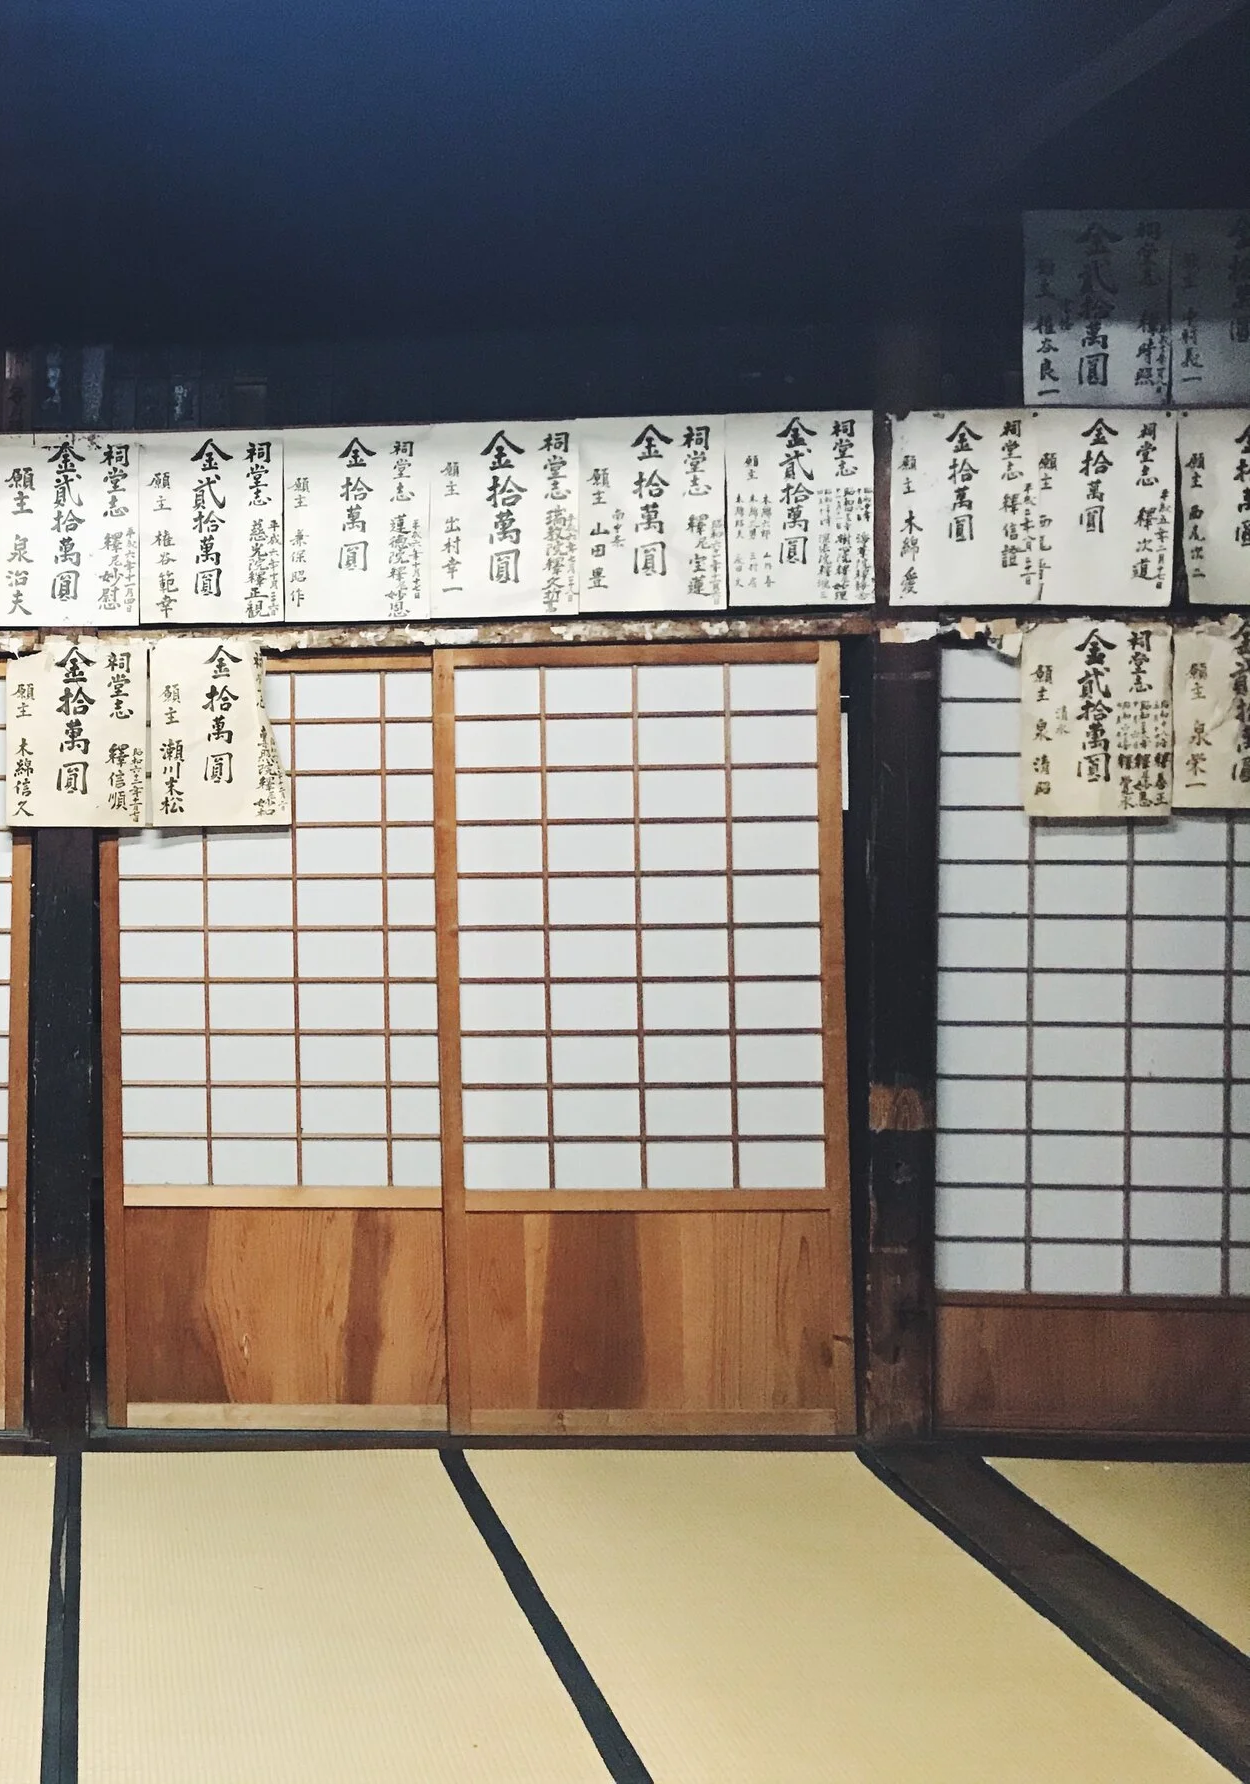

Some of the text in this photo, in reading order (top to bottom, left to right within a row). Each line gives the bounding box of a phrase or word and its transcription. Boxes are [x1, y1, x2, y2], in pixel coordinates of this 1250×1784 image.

[100, 444, 130, 517] 祠堂志
[243, 441, 272, 506] 祠堂志
[390, 441, 415, 502] 祠堂志
[538, 432, 571, 500] 祠堂志
[681, 426, 712, 496] 祠堂志
[830, 419, 858, 477] 祠堂志
[898, 455, 916, 495] 願主
[1000, 420, 1024, 481] 祠堂志
[1079, 418, 1118, 533] 金拾萬圓
[1136, 422, 1159, 486] 祠堂志
[1184, 452, 1205, 488] 願主
[4, 467, 35, 515] 願主
[146, 472, 172, 511] 願主
[287, 477, 310, 508] 願主
[338, 437, 377, 571] 金拾萬圓
[480, 430, 528, 583] 金拾萬圓
[586, 468, 610, 506] 願主
[631, 424, 674, 576] 金拾萬圓
[776, 417, 817, 564] 金貳拾萬圓
[946, 421, 983, 542] 金拾萬圓
[46, 441, 86, 601] 金貳拾萬圓
[190, 438, 233, 597] 金貳拾萬圓
[440, 462, 463, 592] 願主 出村幸一
[105, 652, 134, 719] 祠堂志
[1030, 664, 1053, 702] 願主
[1127, 630, 1153, 693] 祠堂志
[1185, 662, 1208, 700] 願主
[12, 683, 35, 718] 願主
[54, 646, 96, 795] 金拾萬圓
[162, 683, 181, 725] 願主
[202, 645, 242, 783] 金拾萬圓
[1074, 628, 1117, 782] 金貳拾萬圓
